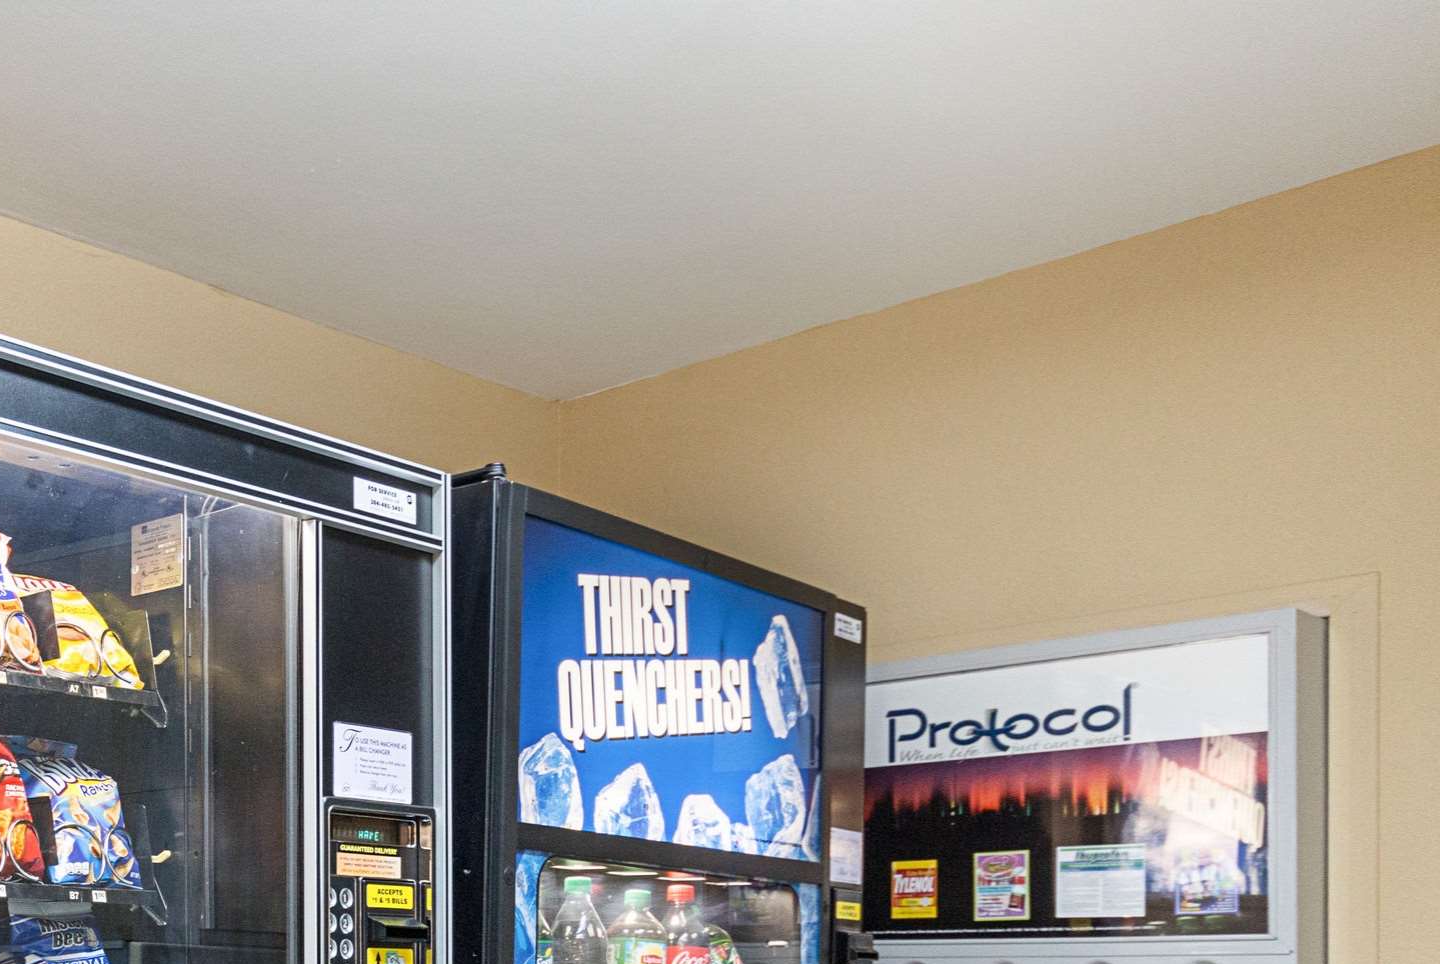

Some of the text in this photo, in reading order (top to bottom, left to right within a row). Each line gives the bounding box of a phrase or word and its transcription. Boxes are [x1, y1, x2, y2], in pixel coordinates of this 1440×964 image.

[577, 573, 690, 655] THIRST
[69, 684, 79, 693] A7
[558, 658, 752, 751] QUENCHERS!
[886, 683, 1137, 763] Protocol
[377, 888, 403, 896] ACCEPTS
[893, 874, 934, 893] TYLENOL
